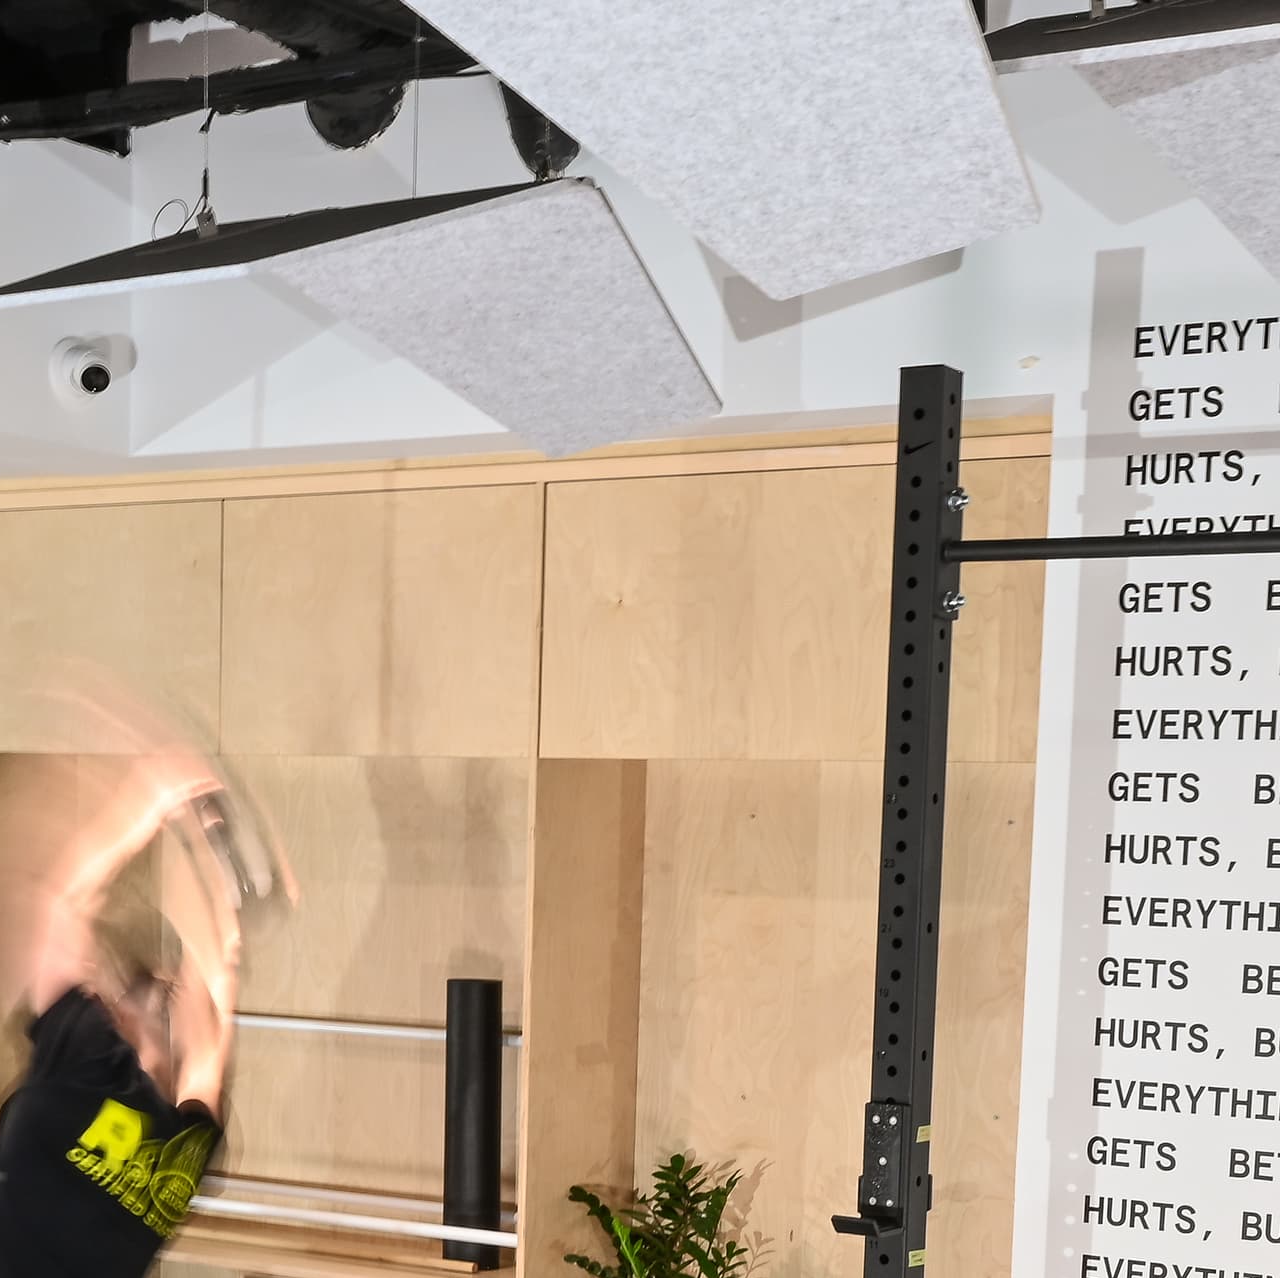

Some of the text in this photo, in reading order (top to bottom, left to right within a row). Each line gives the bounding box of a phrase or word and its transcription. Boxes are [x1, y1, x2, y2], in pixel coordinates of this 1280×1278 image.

[1129, 385, 1224, 422] GETS
[1125, 449, 1261, 486] HURTS,
[1118, 581, 1212, 614] GETS
[1115, 645, 1249, 682] HURTS,
[1108, 771, 1200, 803] GETS
[1104, 833, 1236, 873] HURTS,
[1098, 957, 1189, 990] GETS
[1094, 1017, 1225, 1060] HURTS,
[1087, 1135, 1177, 1172] GETS
[1083, 1194, 1212, 1241] HURTS,
